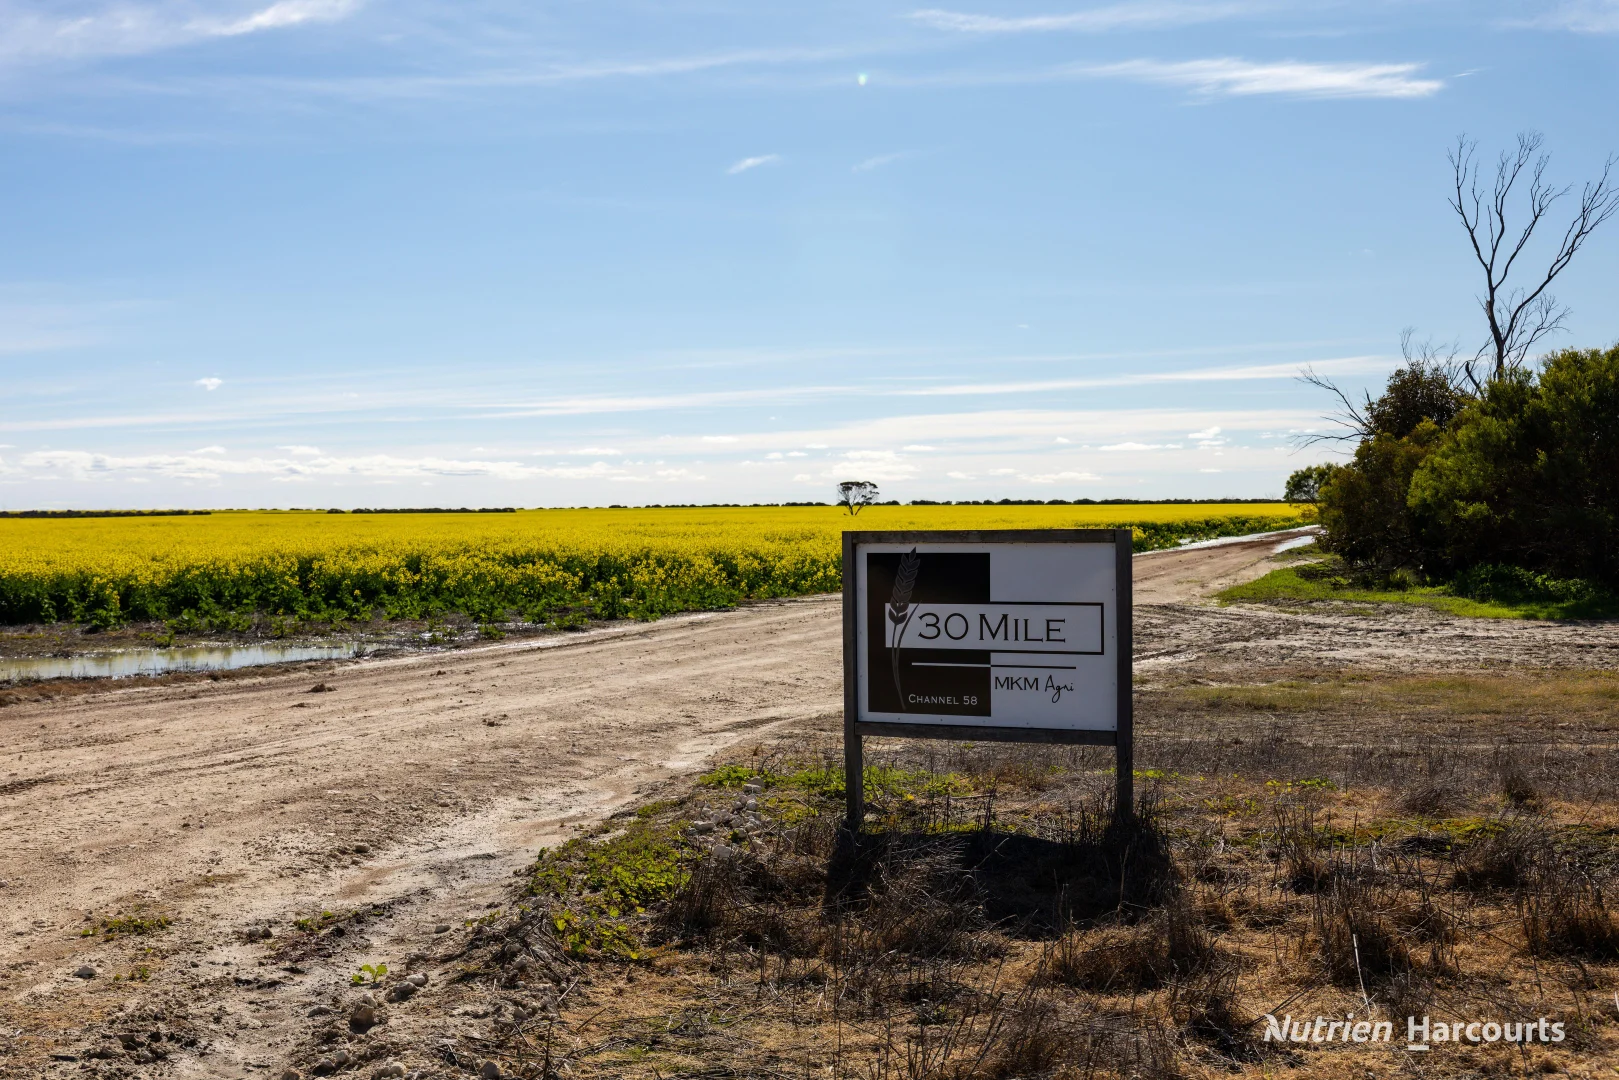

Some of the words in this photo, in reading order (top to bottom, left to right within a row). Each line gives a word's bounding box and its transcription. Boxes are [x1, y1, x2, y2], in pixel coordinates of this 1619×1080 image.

[918, 612, 969, 640] 30
[978, 613, 1066, 643] MILE
[908, 693, 959, 705] CHANNEL
[963, 695, 978, 705] 58
[994, 676, 1039, 691] MKM
[1044, 674, 1074, 703] Agri
